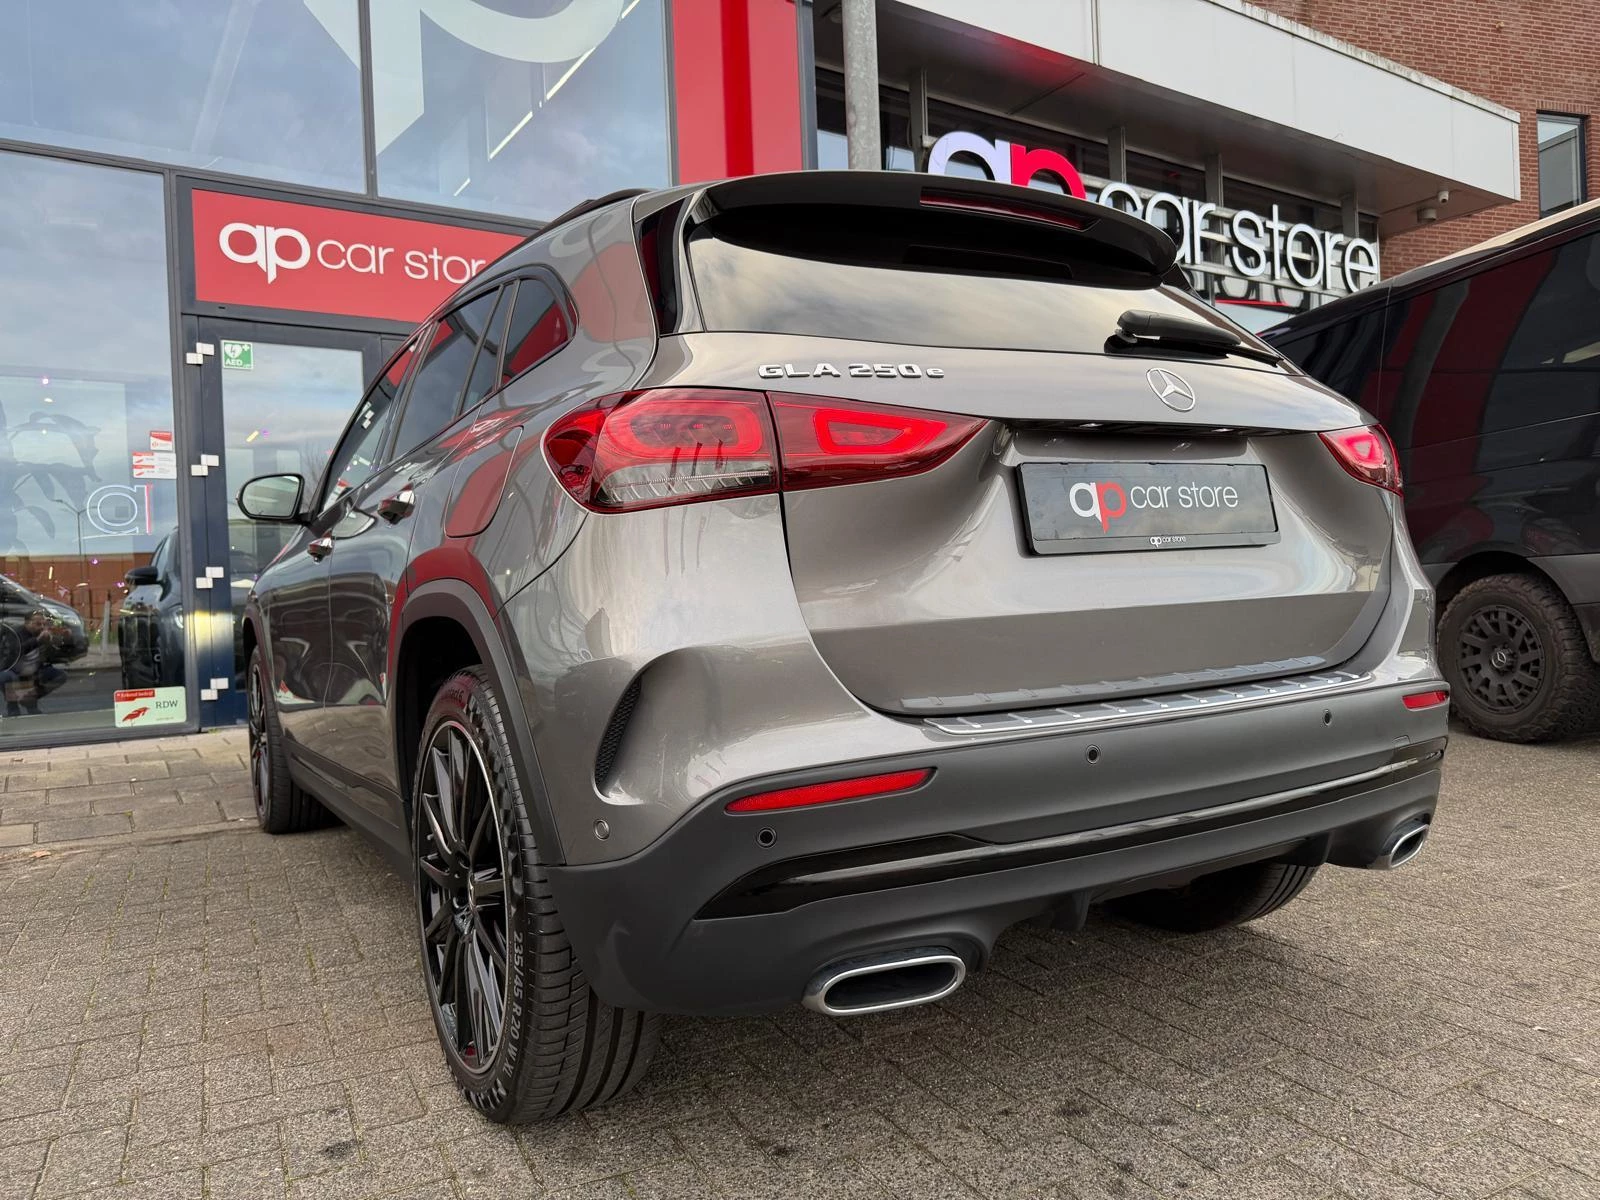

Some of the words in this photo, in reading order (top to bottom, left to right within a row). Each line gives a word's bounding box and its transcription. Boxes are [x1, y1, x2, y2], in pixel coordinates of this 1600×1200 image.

[219, 222, 311, 284] ap
[317, 239, 394, 275] car
[404, 247, 486, 284] stor
[1232, 204, 1378, 292] store
[225, 358, 243, 367] AED
[758, 363, 841, 378] GLA
[1069, 480, 1127, 534] ap
[1130, 485, 1172, 509] car
[1178, 481, 1239, 508] store
[155, 700, 178, 709] RDW
[513, 930, 524, 1000] 235/45
